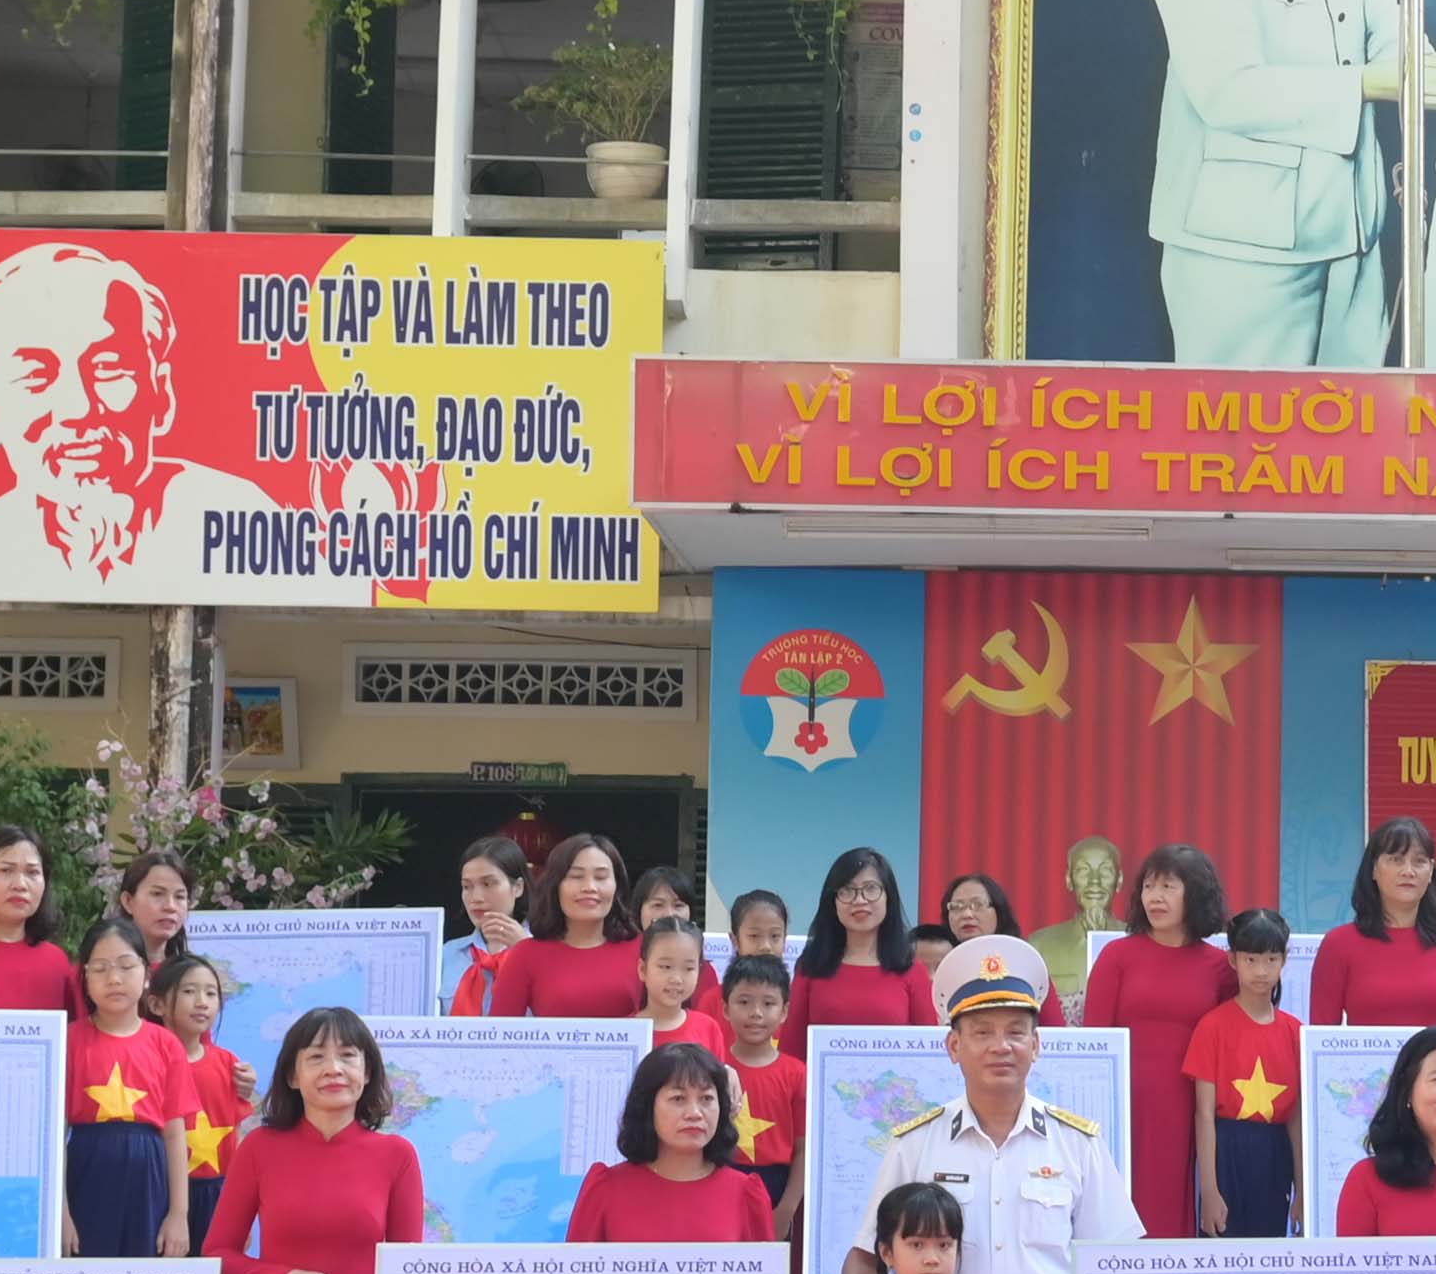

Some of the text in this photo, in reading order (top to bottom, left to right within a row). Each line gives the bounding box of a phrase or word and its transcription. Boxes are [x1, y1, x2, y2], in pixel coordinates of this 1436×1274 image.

[242, 265, 608, 357] HỌC TẬP VÀ LÀM THEO
[256, 373, 589, 476] TƯ TƯỞNG, ĐẠO ĐỨC,
[784, 368, 852, 425] VÌ
[883, 378, 997, 435] LỢI
[1031, 376, 1152, 430] ÍCH
[1186, 380, 1375, 434] MƯỜI
[736, 434, 803, 484] VÌ
[836, 443, 953, 496] LỢI
[987, 438, 1111, 491] ÍCH
[1141, 443, 1345, 495] TRĂM
[203, 492, 639, 582] PHONG CÁCH HỒ CHÍ MINH
[458, 1258, 494, 1273] HÒA
[502, 1259, 526, 1273] XÃ
[533, 1259, 563, 1274] HỘI
[570, 1256, 605, 1273] CHỦ
[612, 1259, 668, 1272] NGHĨA
[676, 1258, 716, 1274] VIỆT
[722, 1261, 762, 1272] NAM
[1098, 1255, 1144, 1272] CỘNG
[1151, 1255, 1187, 1269] HÒA
[1194, 1254, 1217, 1268] XÃ
[1224, 1253, 1253, 1270] HỘI
[1260, 1253, 1294, 1267] CHỦ
[1302, 1253, 1356, 1267] NGHĨA
[1363, 1252, 1403, 1269] VIỆT
